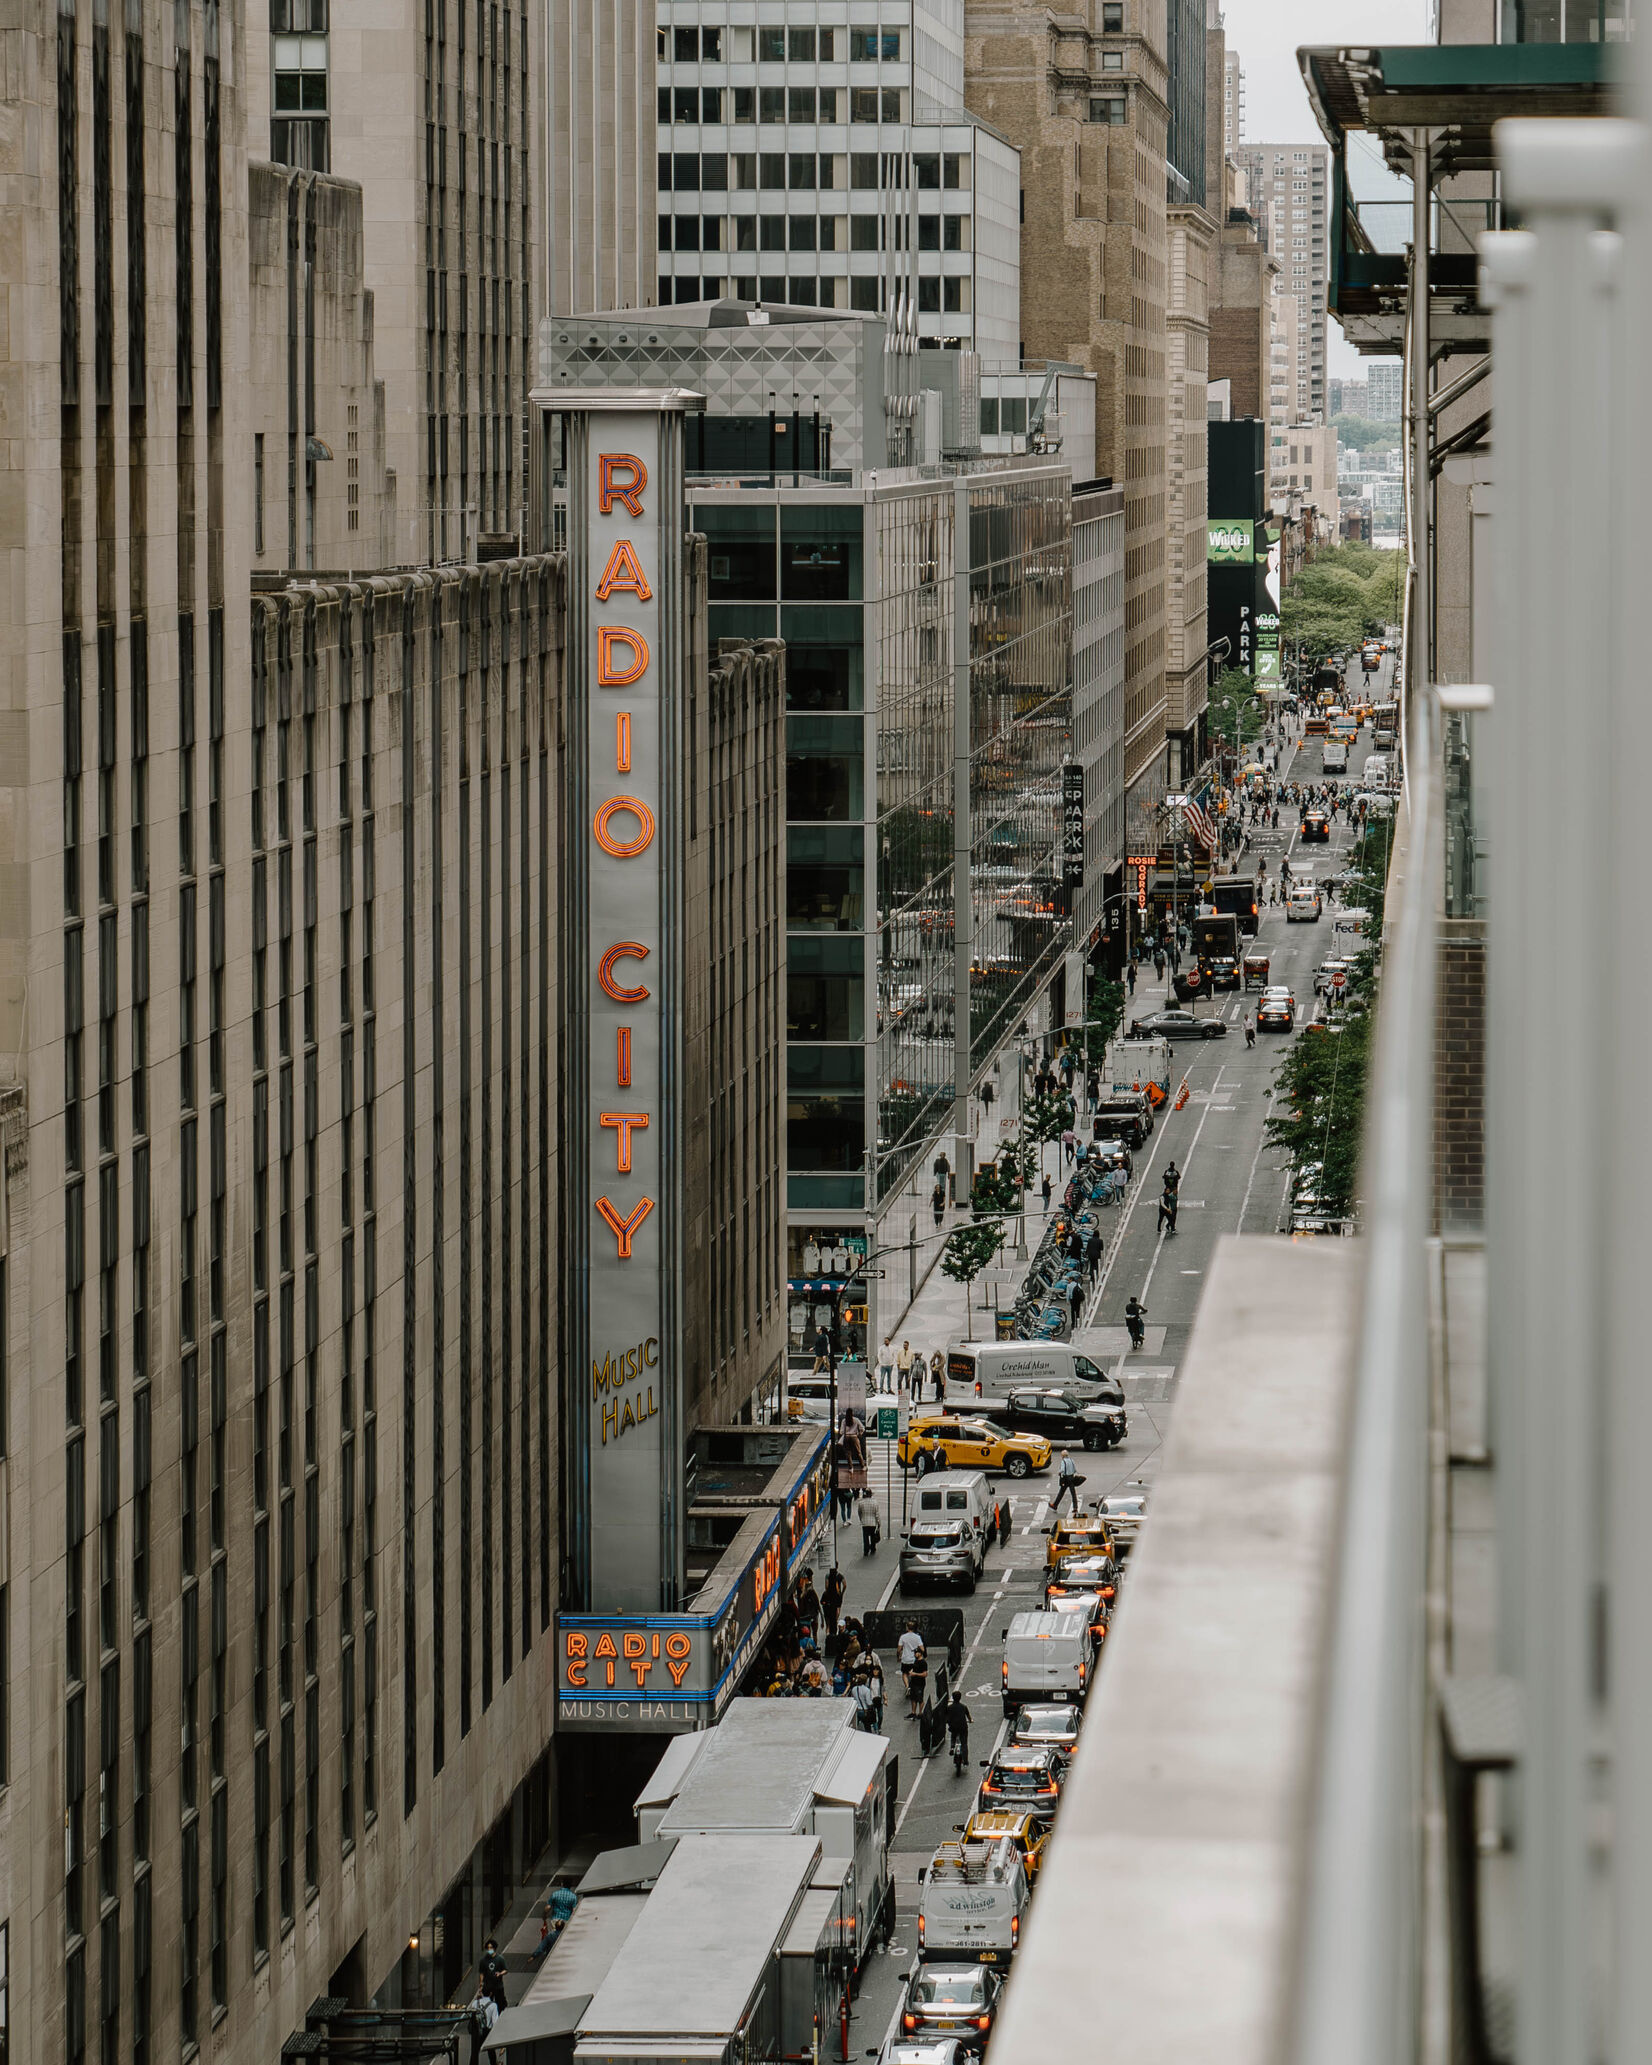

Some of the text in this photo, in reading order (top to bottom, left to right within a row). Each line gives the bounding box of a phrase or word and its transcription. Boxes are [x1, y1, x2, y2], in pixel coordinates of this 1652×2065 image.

[1240, 606, 1250, 661] PARK
[1073, 790, 1083, 848] PARK
[593, 452, 655, 1258] RADIO CITY
[1128, 857, 1157, 865] ROSIE
[1335, 922, 1366, 934] FedE
[1000, 1119, 1018, 1128] 1271
[592, 1337, 659, 1403] MUSIC
[1001, 1360, 1050, 1371] Orchid Man
[602, 1385, 658, 1446] HALL
[566, 1632, 692, 1660] RADIO
[566, 1660, 691, 1687] CITY
[561, 1701, 696, 1719] MUSIC HALL
